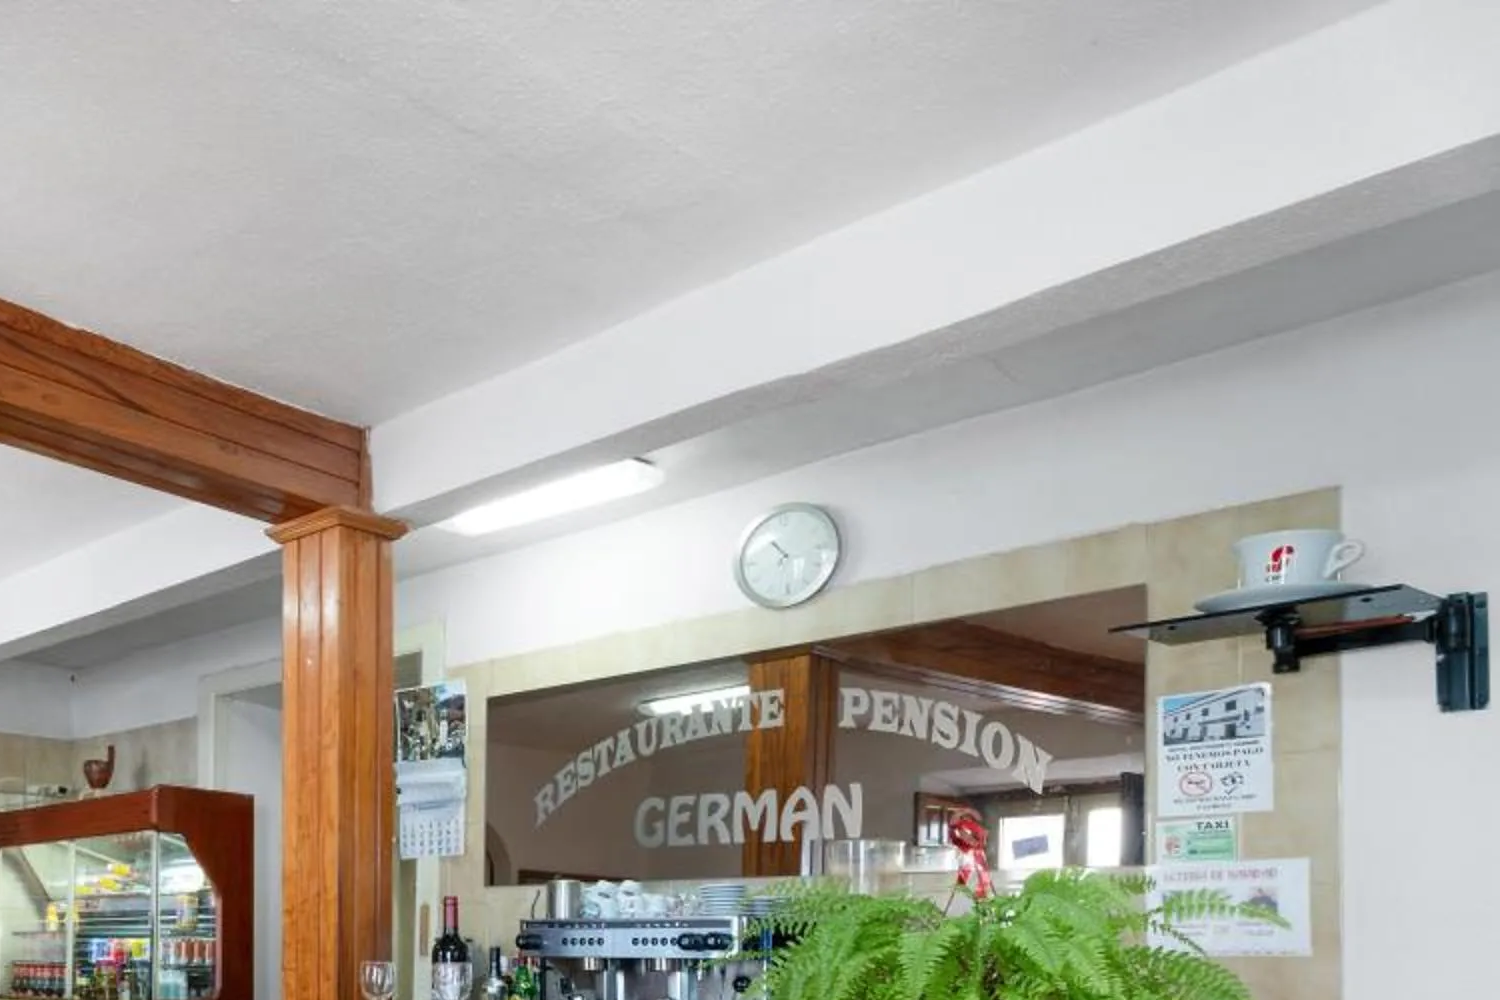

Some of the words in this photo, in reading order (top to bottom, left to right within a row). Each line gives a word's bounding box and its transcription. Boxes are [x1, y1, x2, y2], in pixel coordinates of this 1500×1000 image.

[534, 689, 784, 828] RESTAURANTE
[838, 688, 1053, 795] PENSION
[634, 783, 864, 848] GERMAN
[1196, 819, 1229, 830] TAXI
